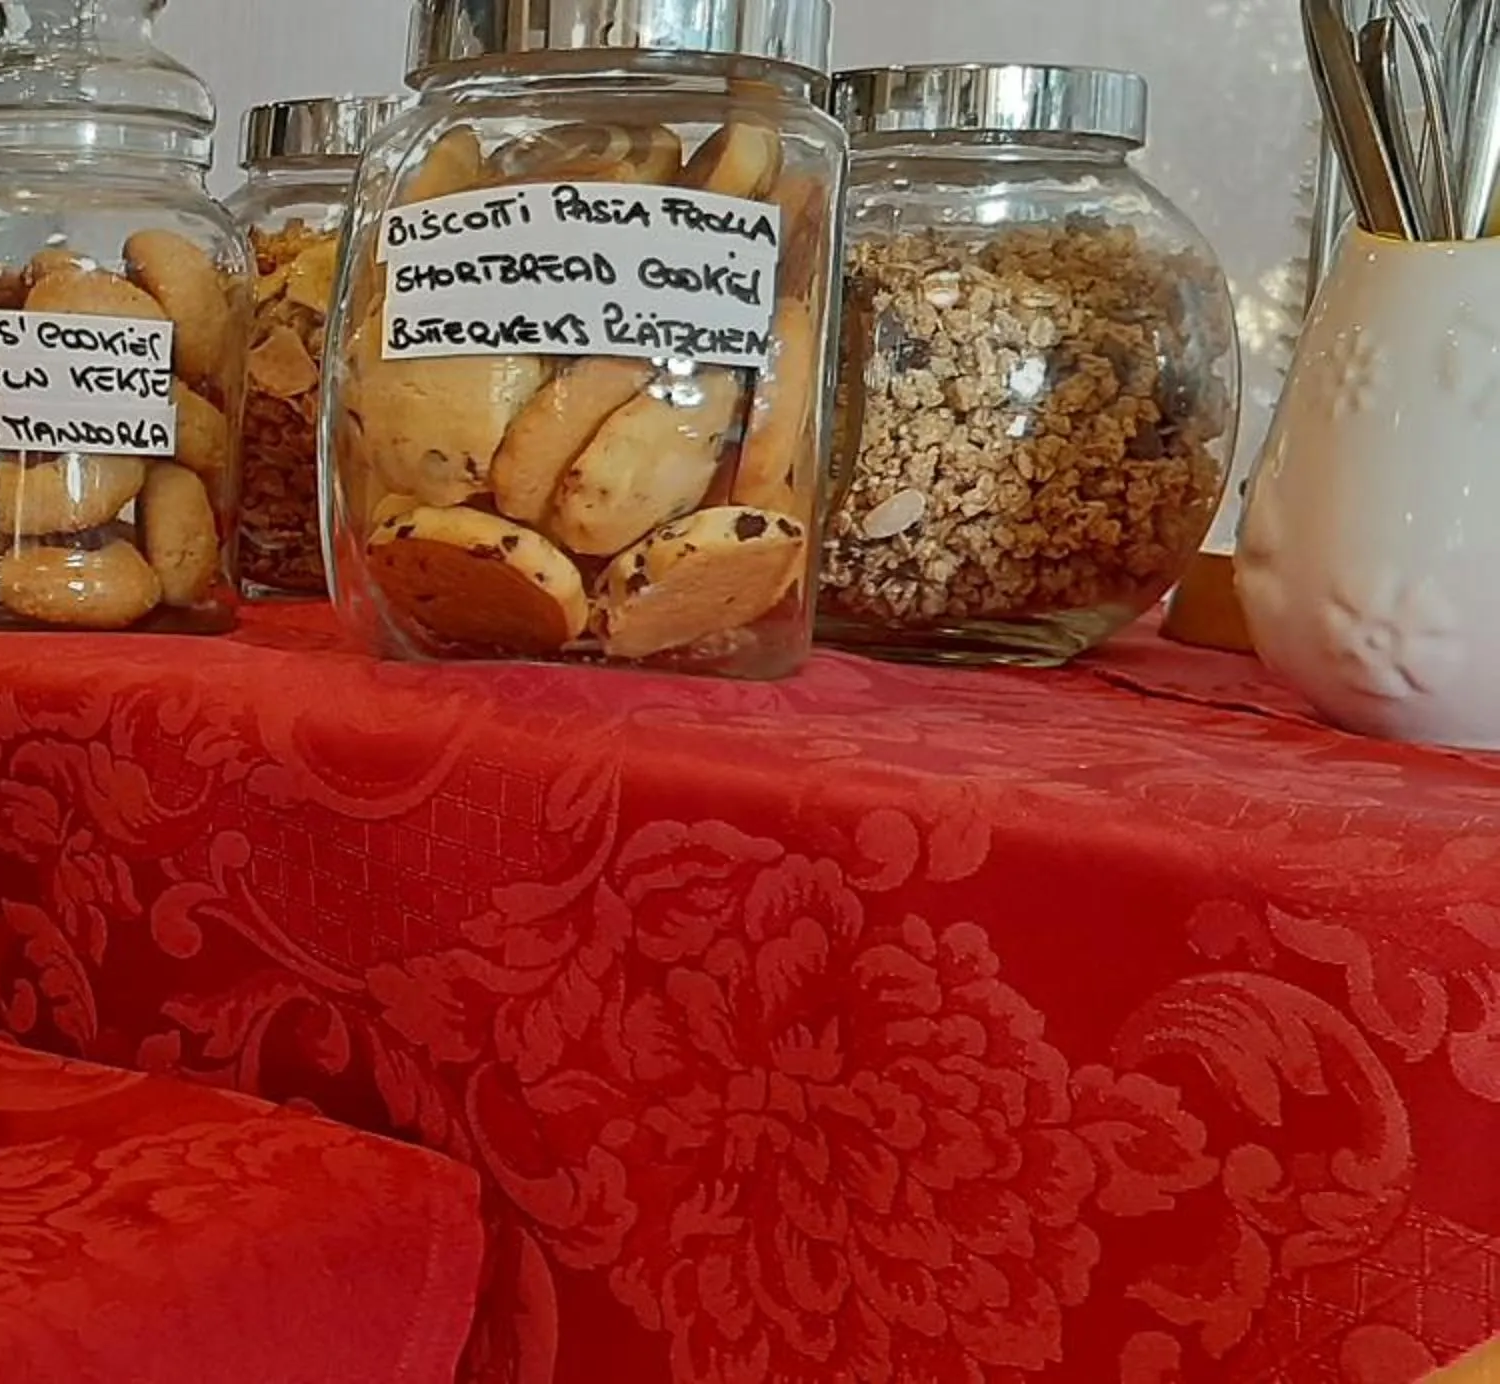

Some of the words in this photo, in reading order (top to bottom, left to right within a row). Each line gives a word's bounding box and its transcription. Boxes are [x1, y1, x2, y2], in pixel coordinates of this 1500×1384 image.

[662, 198, 778, 247] FROLLA
[395, 253, 617, 293] SHORTBREAD
[602, 302, 771, 357] PLÄTZCHEN
[69, 365, 172, 397] KEKSE
[1, 414, 170, 448] MANDORLA
